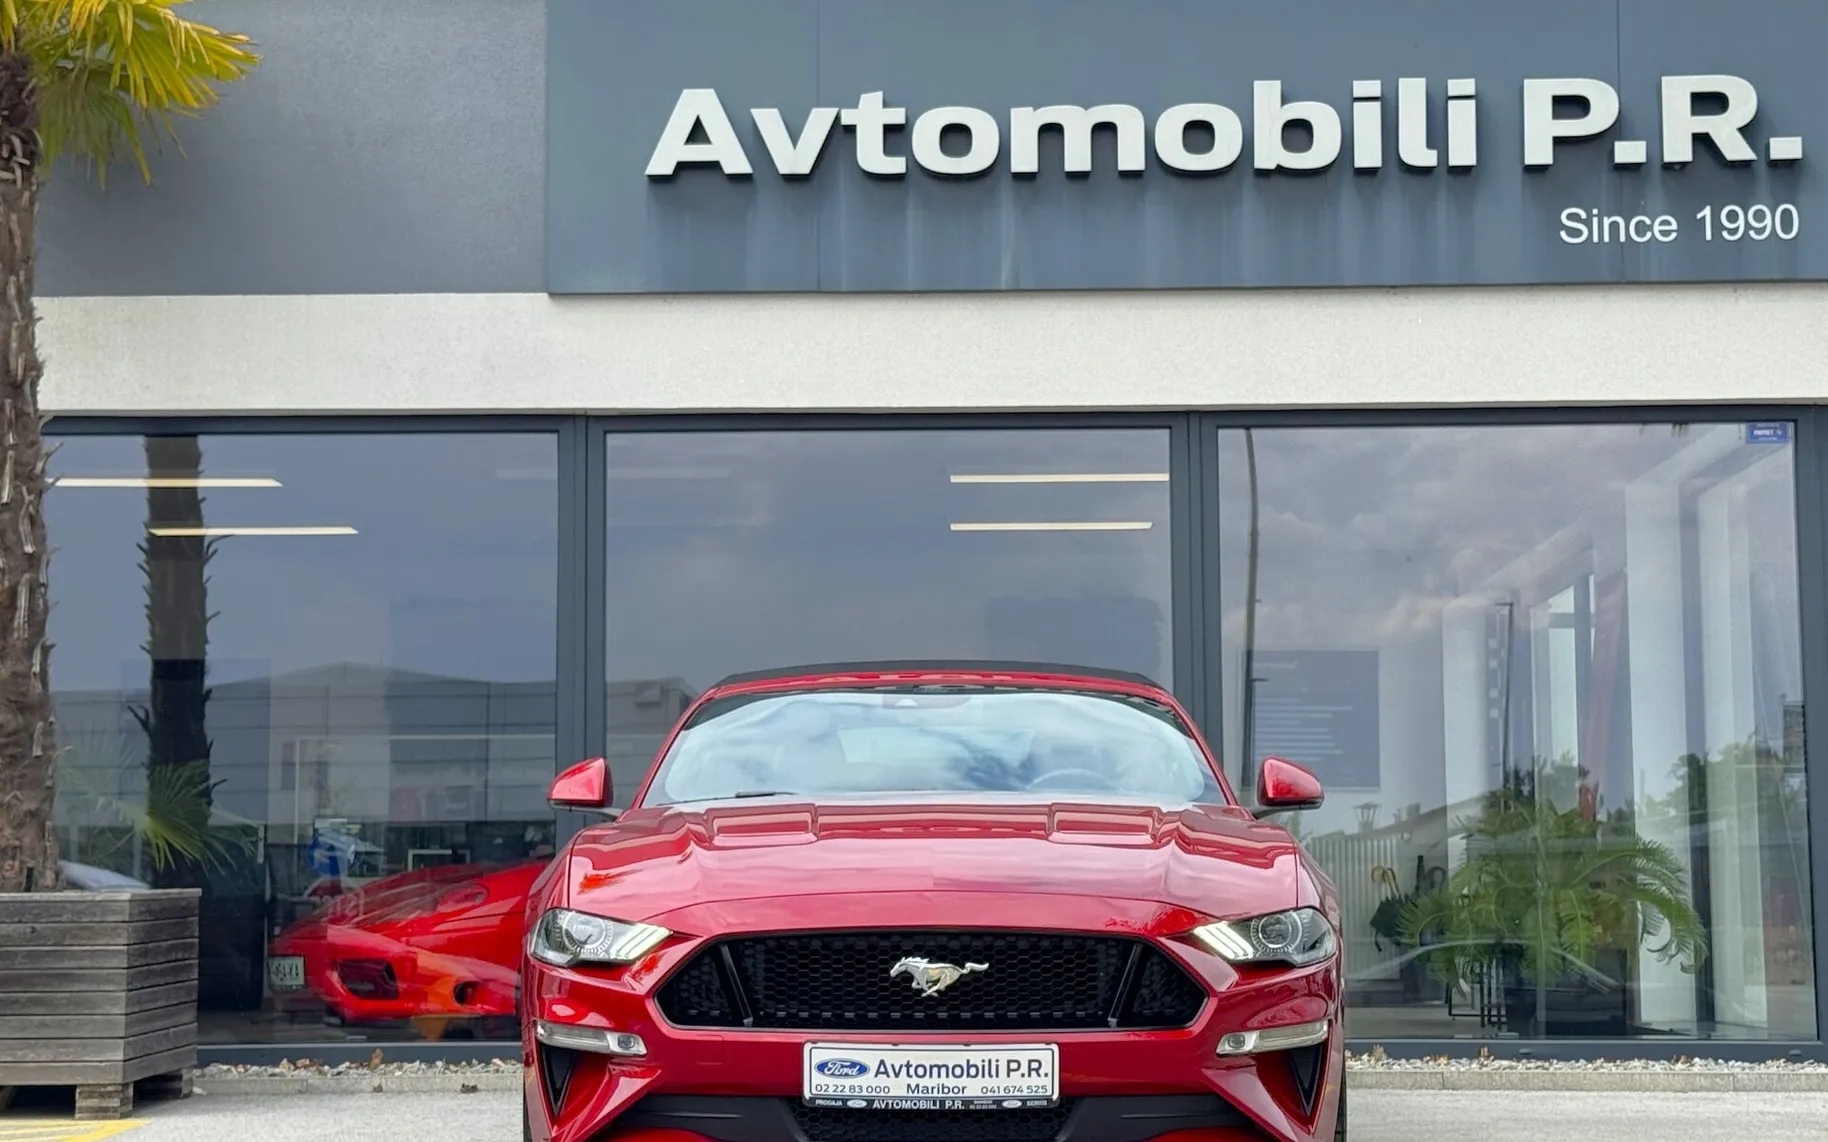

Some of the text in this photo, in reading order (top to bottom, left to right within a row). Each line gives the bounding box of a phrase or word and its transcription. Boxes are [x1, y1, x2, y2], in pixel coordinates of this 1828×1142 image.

[644, 74, 1803, 178] Avtomobili P.R.
[1559, 203, 1800, 244] Since 1990
[823, 1060, 860, 1076] Ford
[874, 1058, 1049, 1079] Avtomobili P.R.
[815, 1083, 891, 1095] 02 22 83 000
[906, 1083, 967, 1095] Maribor
[980, 1085, 1048, 1095] 041 674 525
[872, 1099, 940, 1110] AVTOMOBILI
[945, 1100, 965, 1110] P.R.
